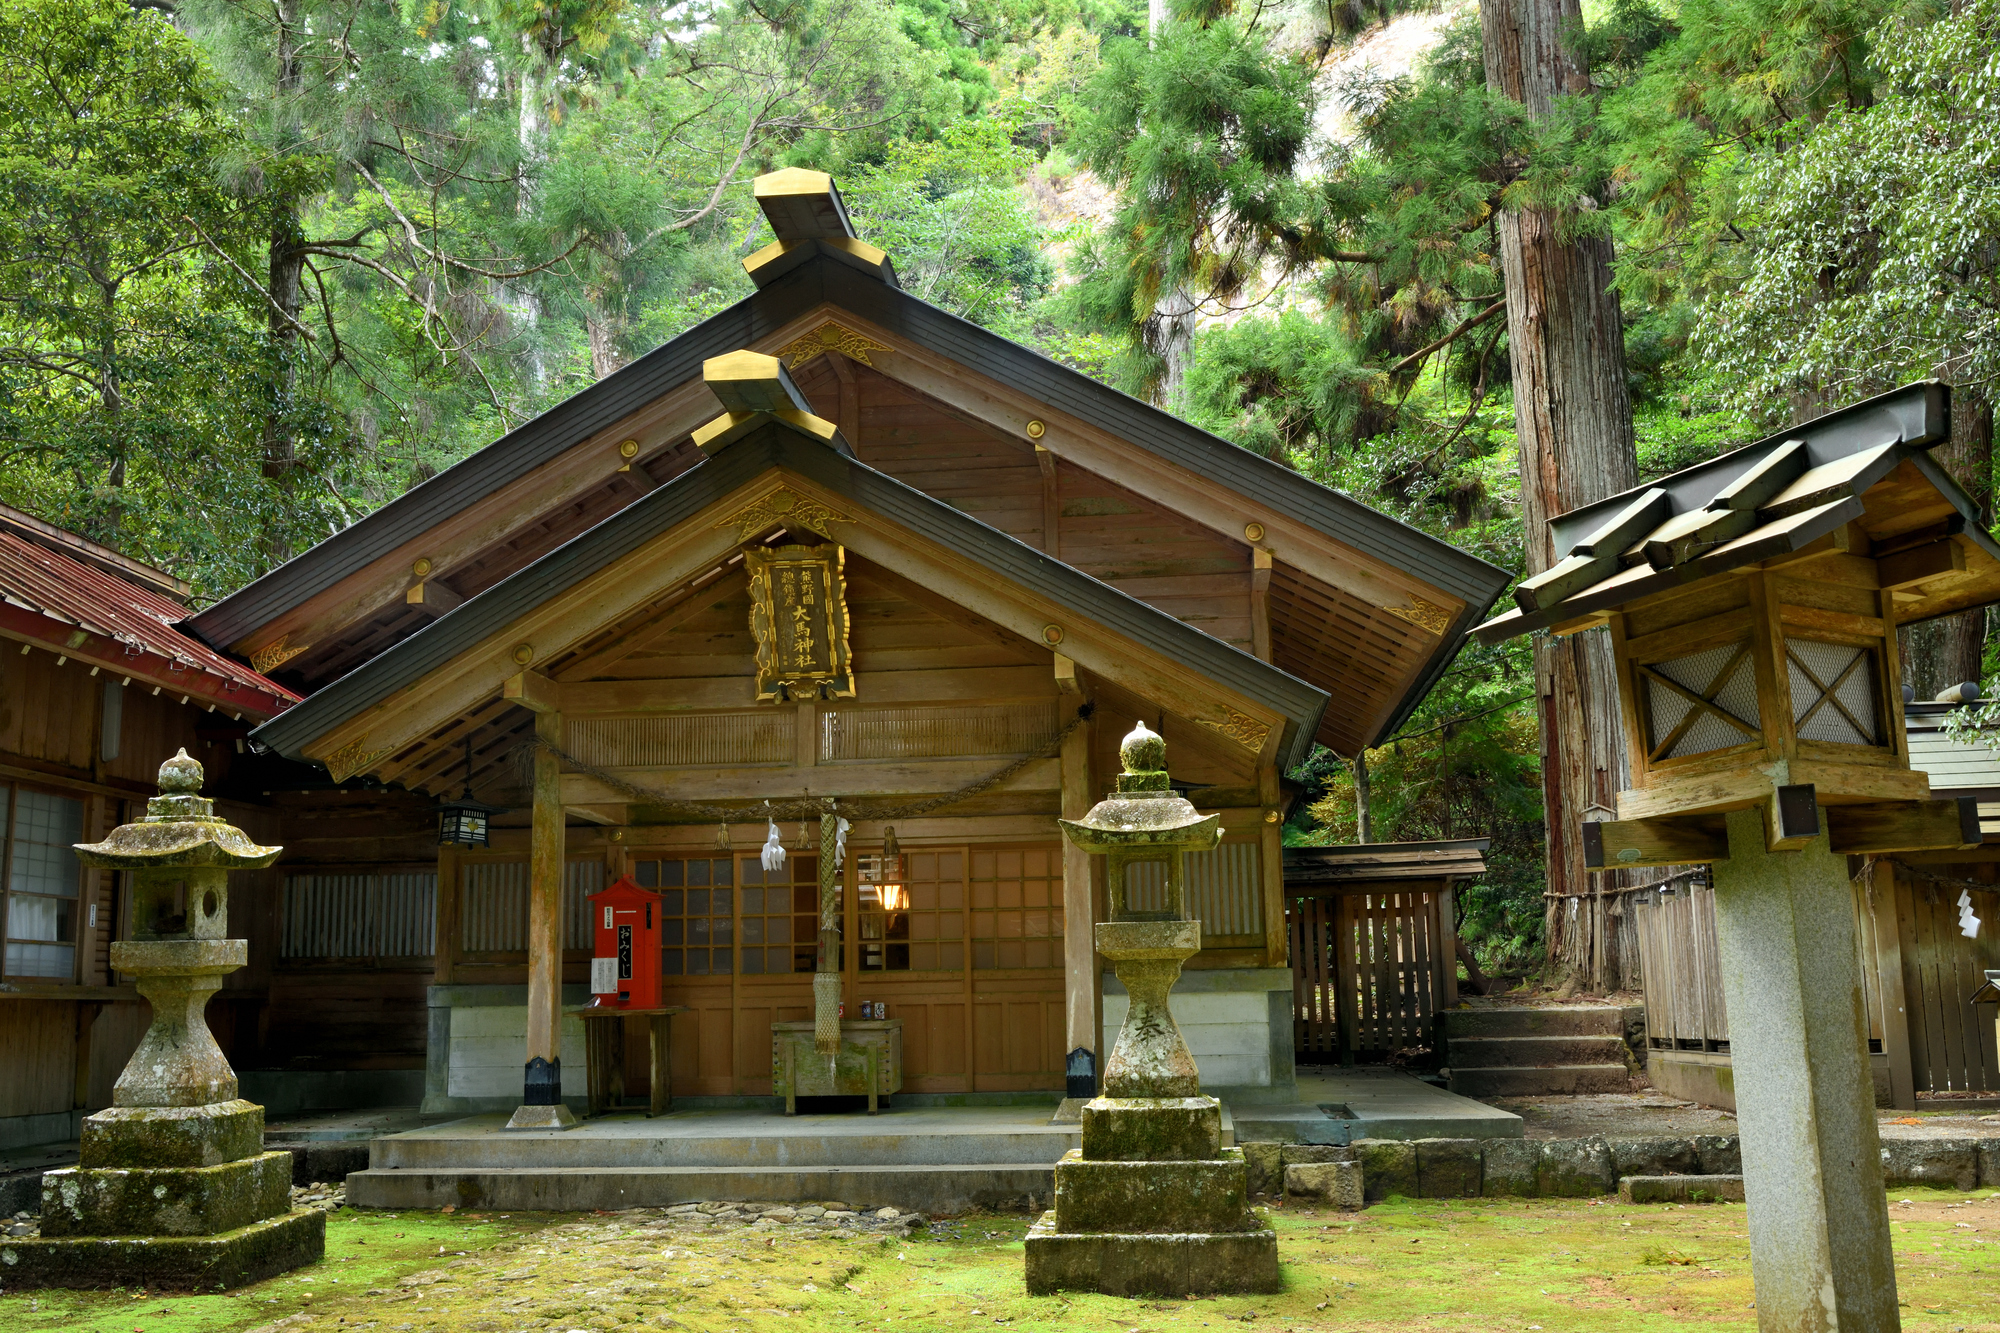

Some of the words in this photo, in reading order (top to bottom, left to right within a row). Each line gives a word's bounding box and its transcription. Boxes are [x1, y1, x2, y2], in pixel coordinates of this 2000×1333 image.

[792, 605, 816, 668] 大馬神社
[620, 927, 630, 978] おみくじ
[1134, 1009, 1165, 1047] 奉
